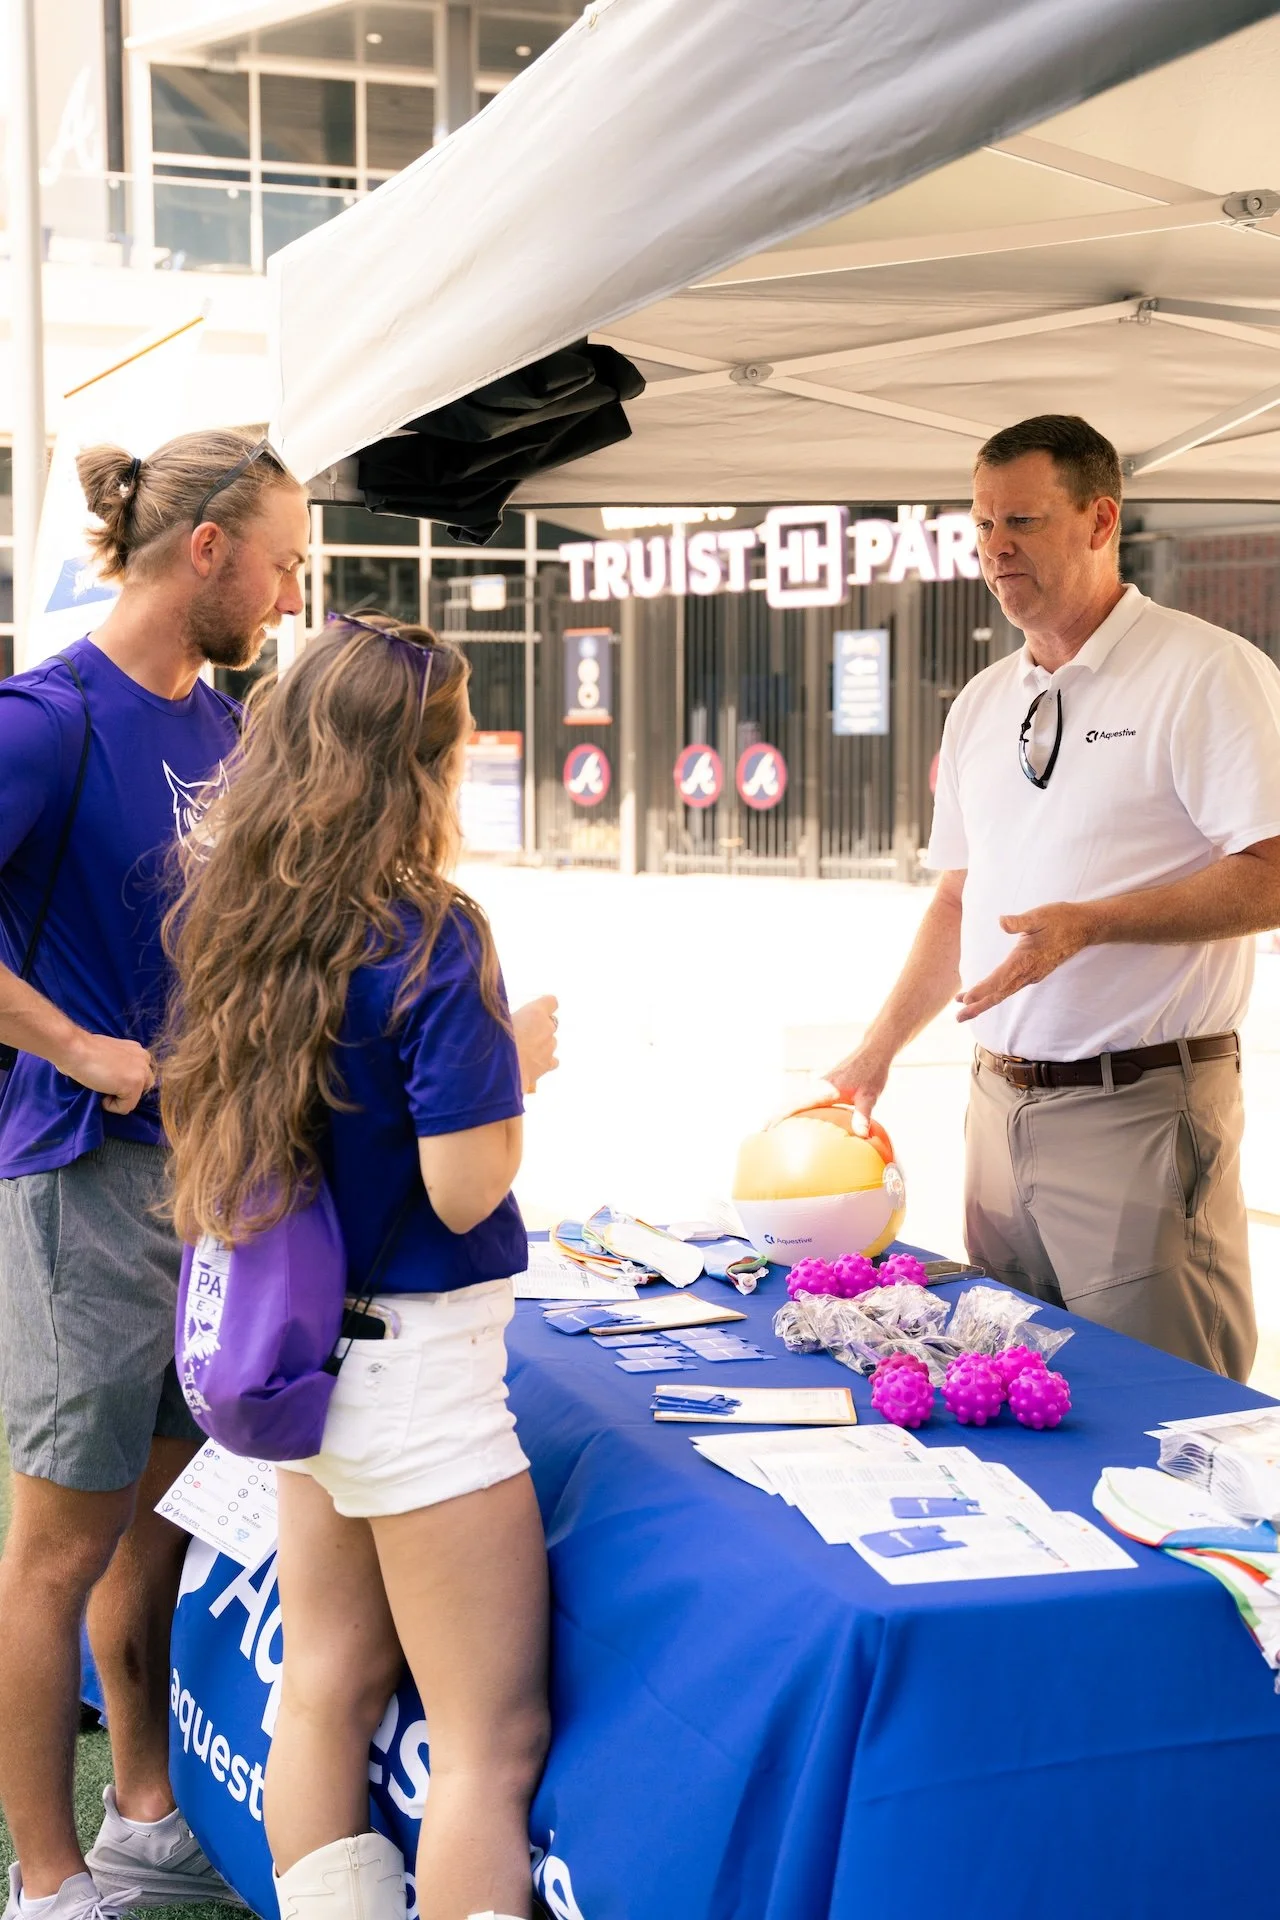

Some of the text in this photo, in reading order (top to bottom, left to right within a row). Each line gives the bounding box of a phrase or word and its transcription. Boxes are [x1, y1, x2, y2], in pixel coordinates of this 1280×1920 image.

[559, 512, 980, 602] TRUIST PAR
[1099, 728, 1136, 740] Aquestive
[776, 1237, 813, 1246] Aquestive
[170, 1667, 264, 1821] aquest
